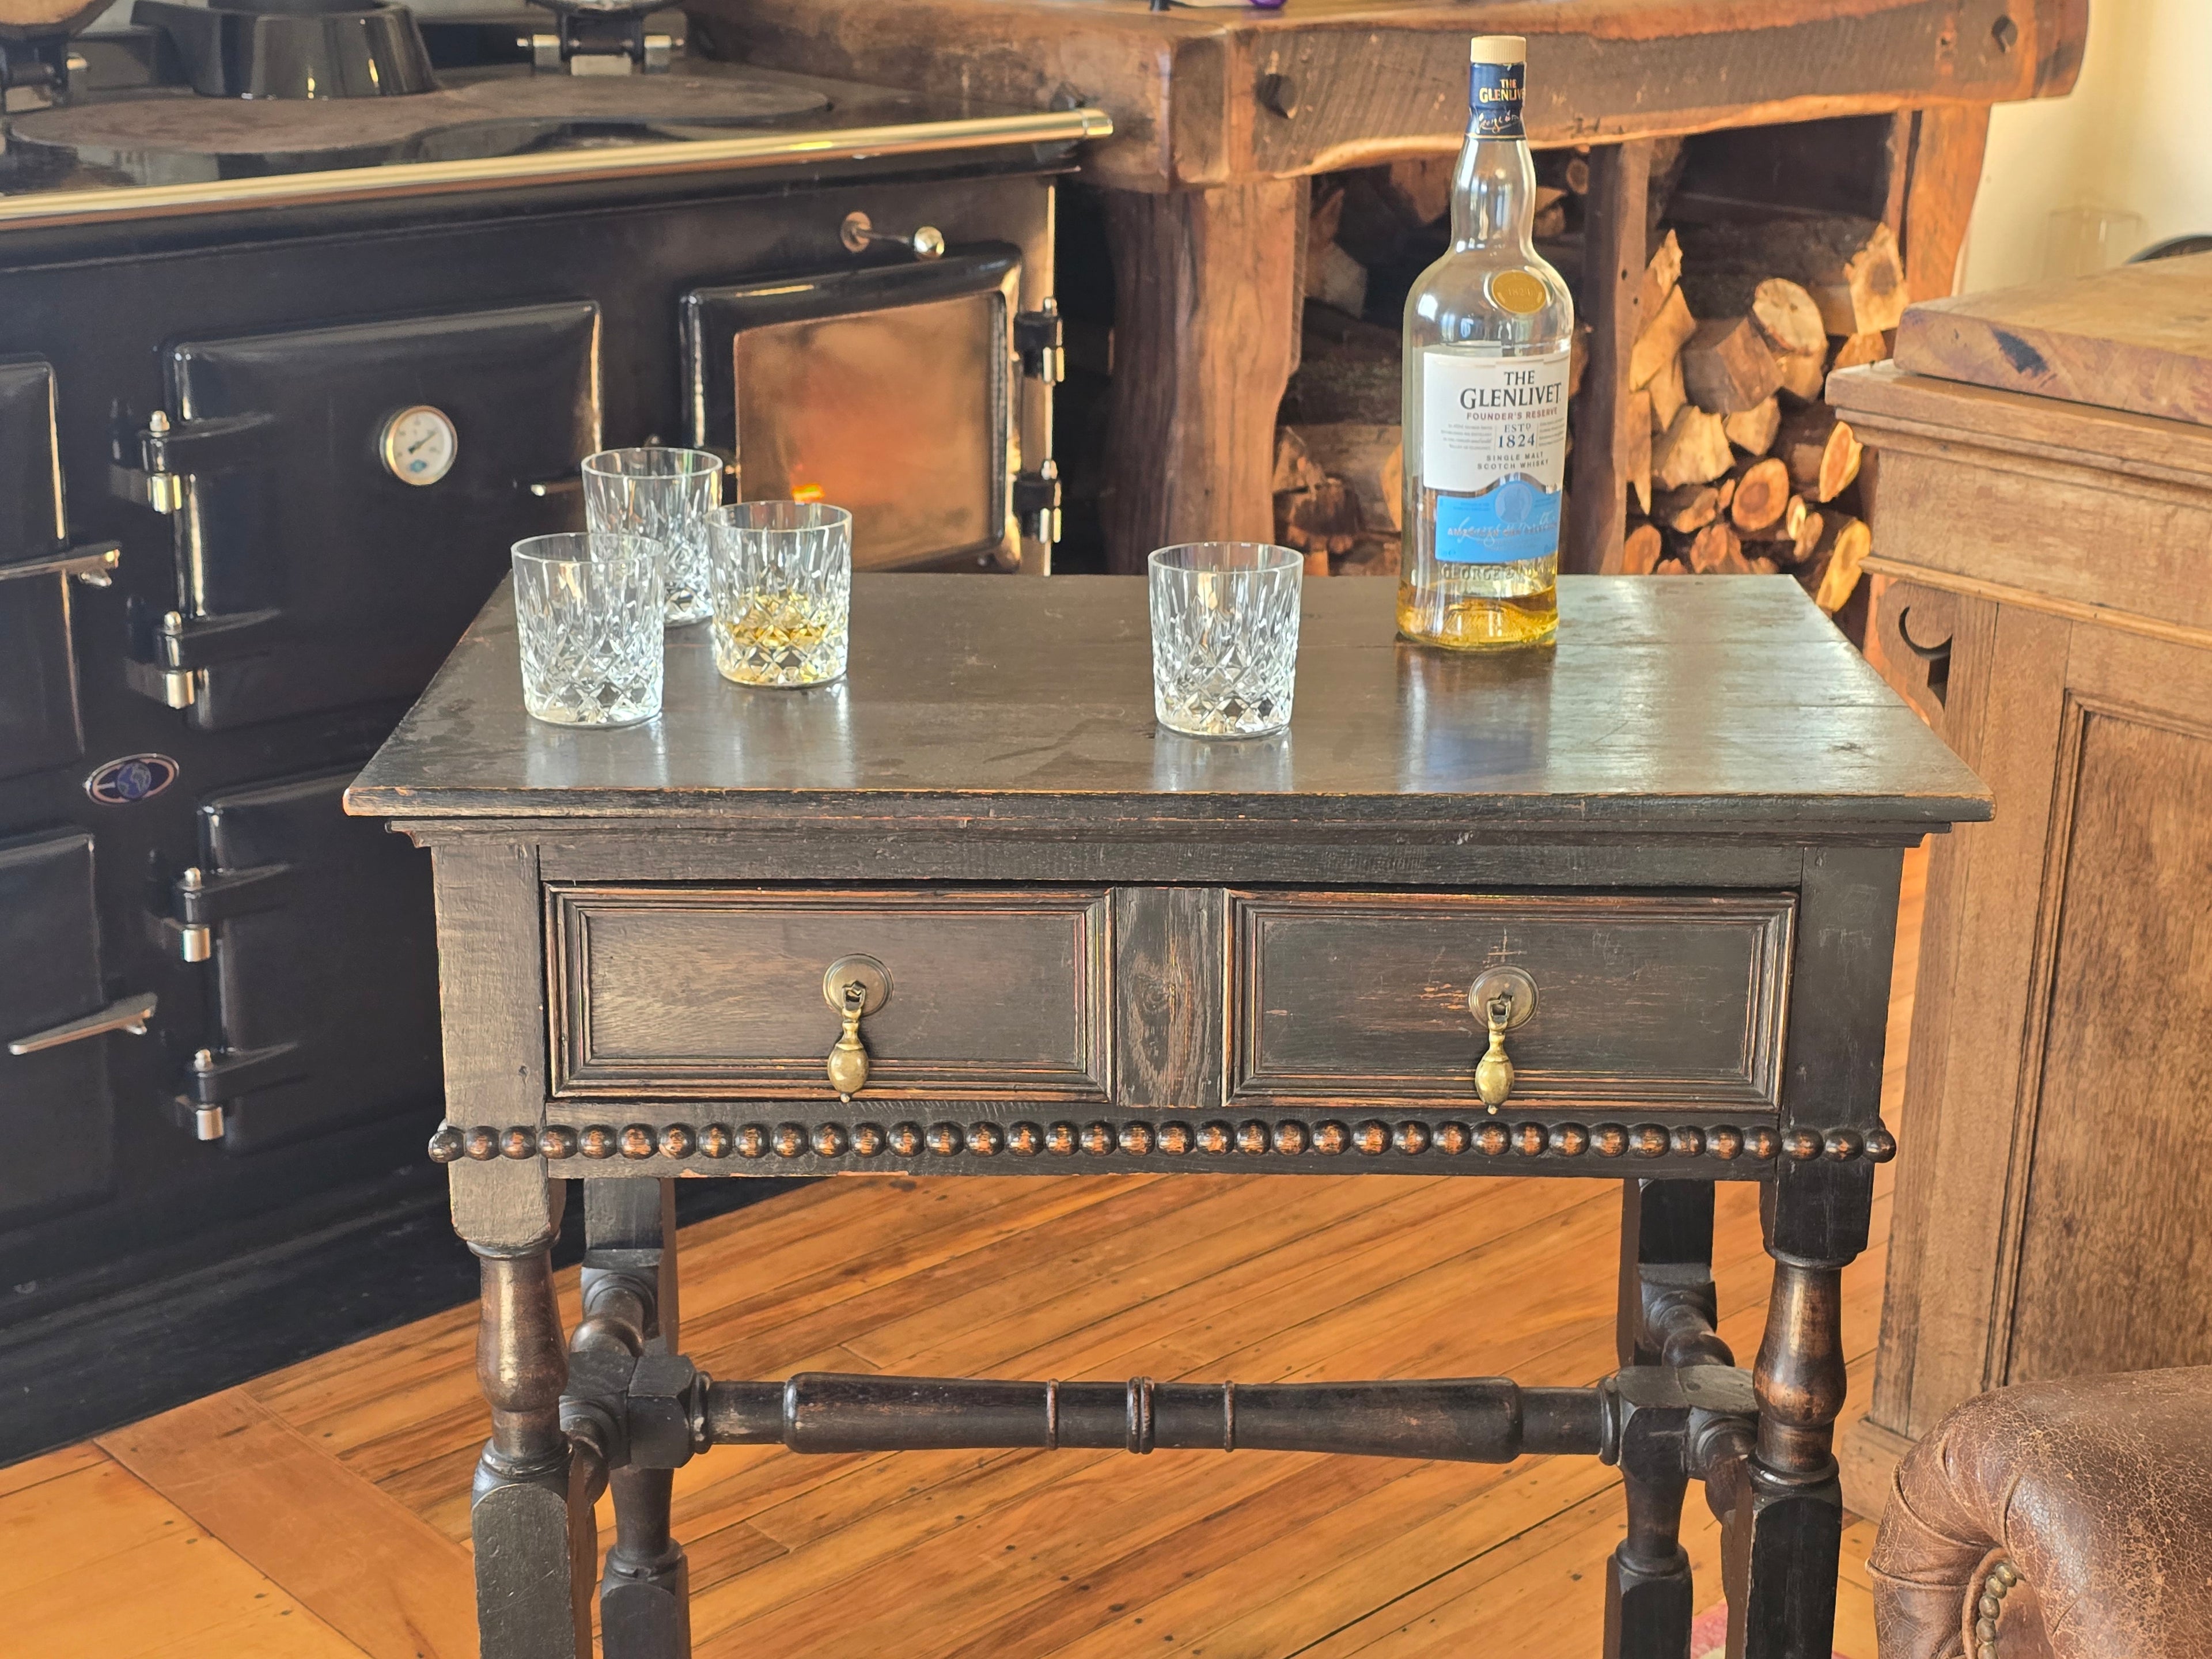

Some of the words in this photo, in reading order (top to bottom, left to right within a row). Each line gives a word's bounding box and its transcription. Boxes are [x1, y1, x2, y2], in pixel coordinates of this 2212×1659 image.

[1499, 78, 1517, 89] THE
[1504, 370, 1535, 385] THE
[1460, 382, 1562, 410] GLENLIVET
[1467, 412, 1522, 421] FOUNDER'S
[1526, 407, 1557, 419] RESERVE
[1499, 433, 1535, 448] 1824
[1525, 452, 1543, 460] MALT
[1520, 459, 1548, 468] WHISKY
